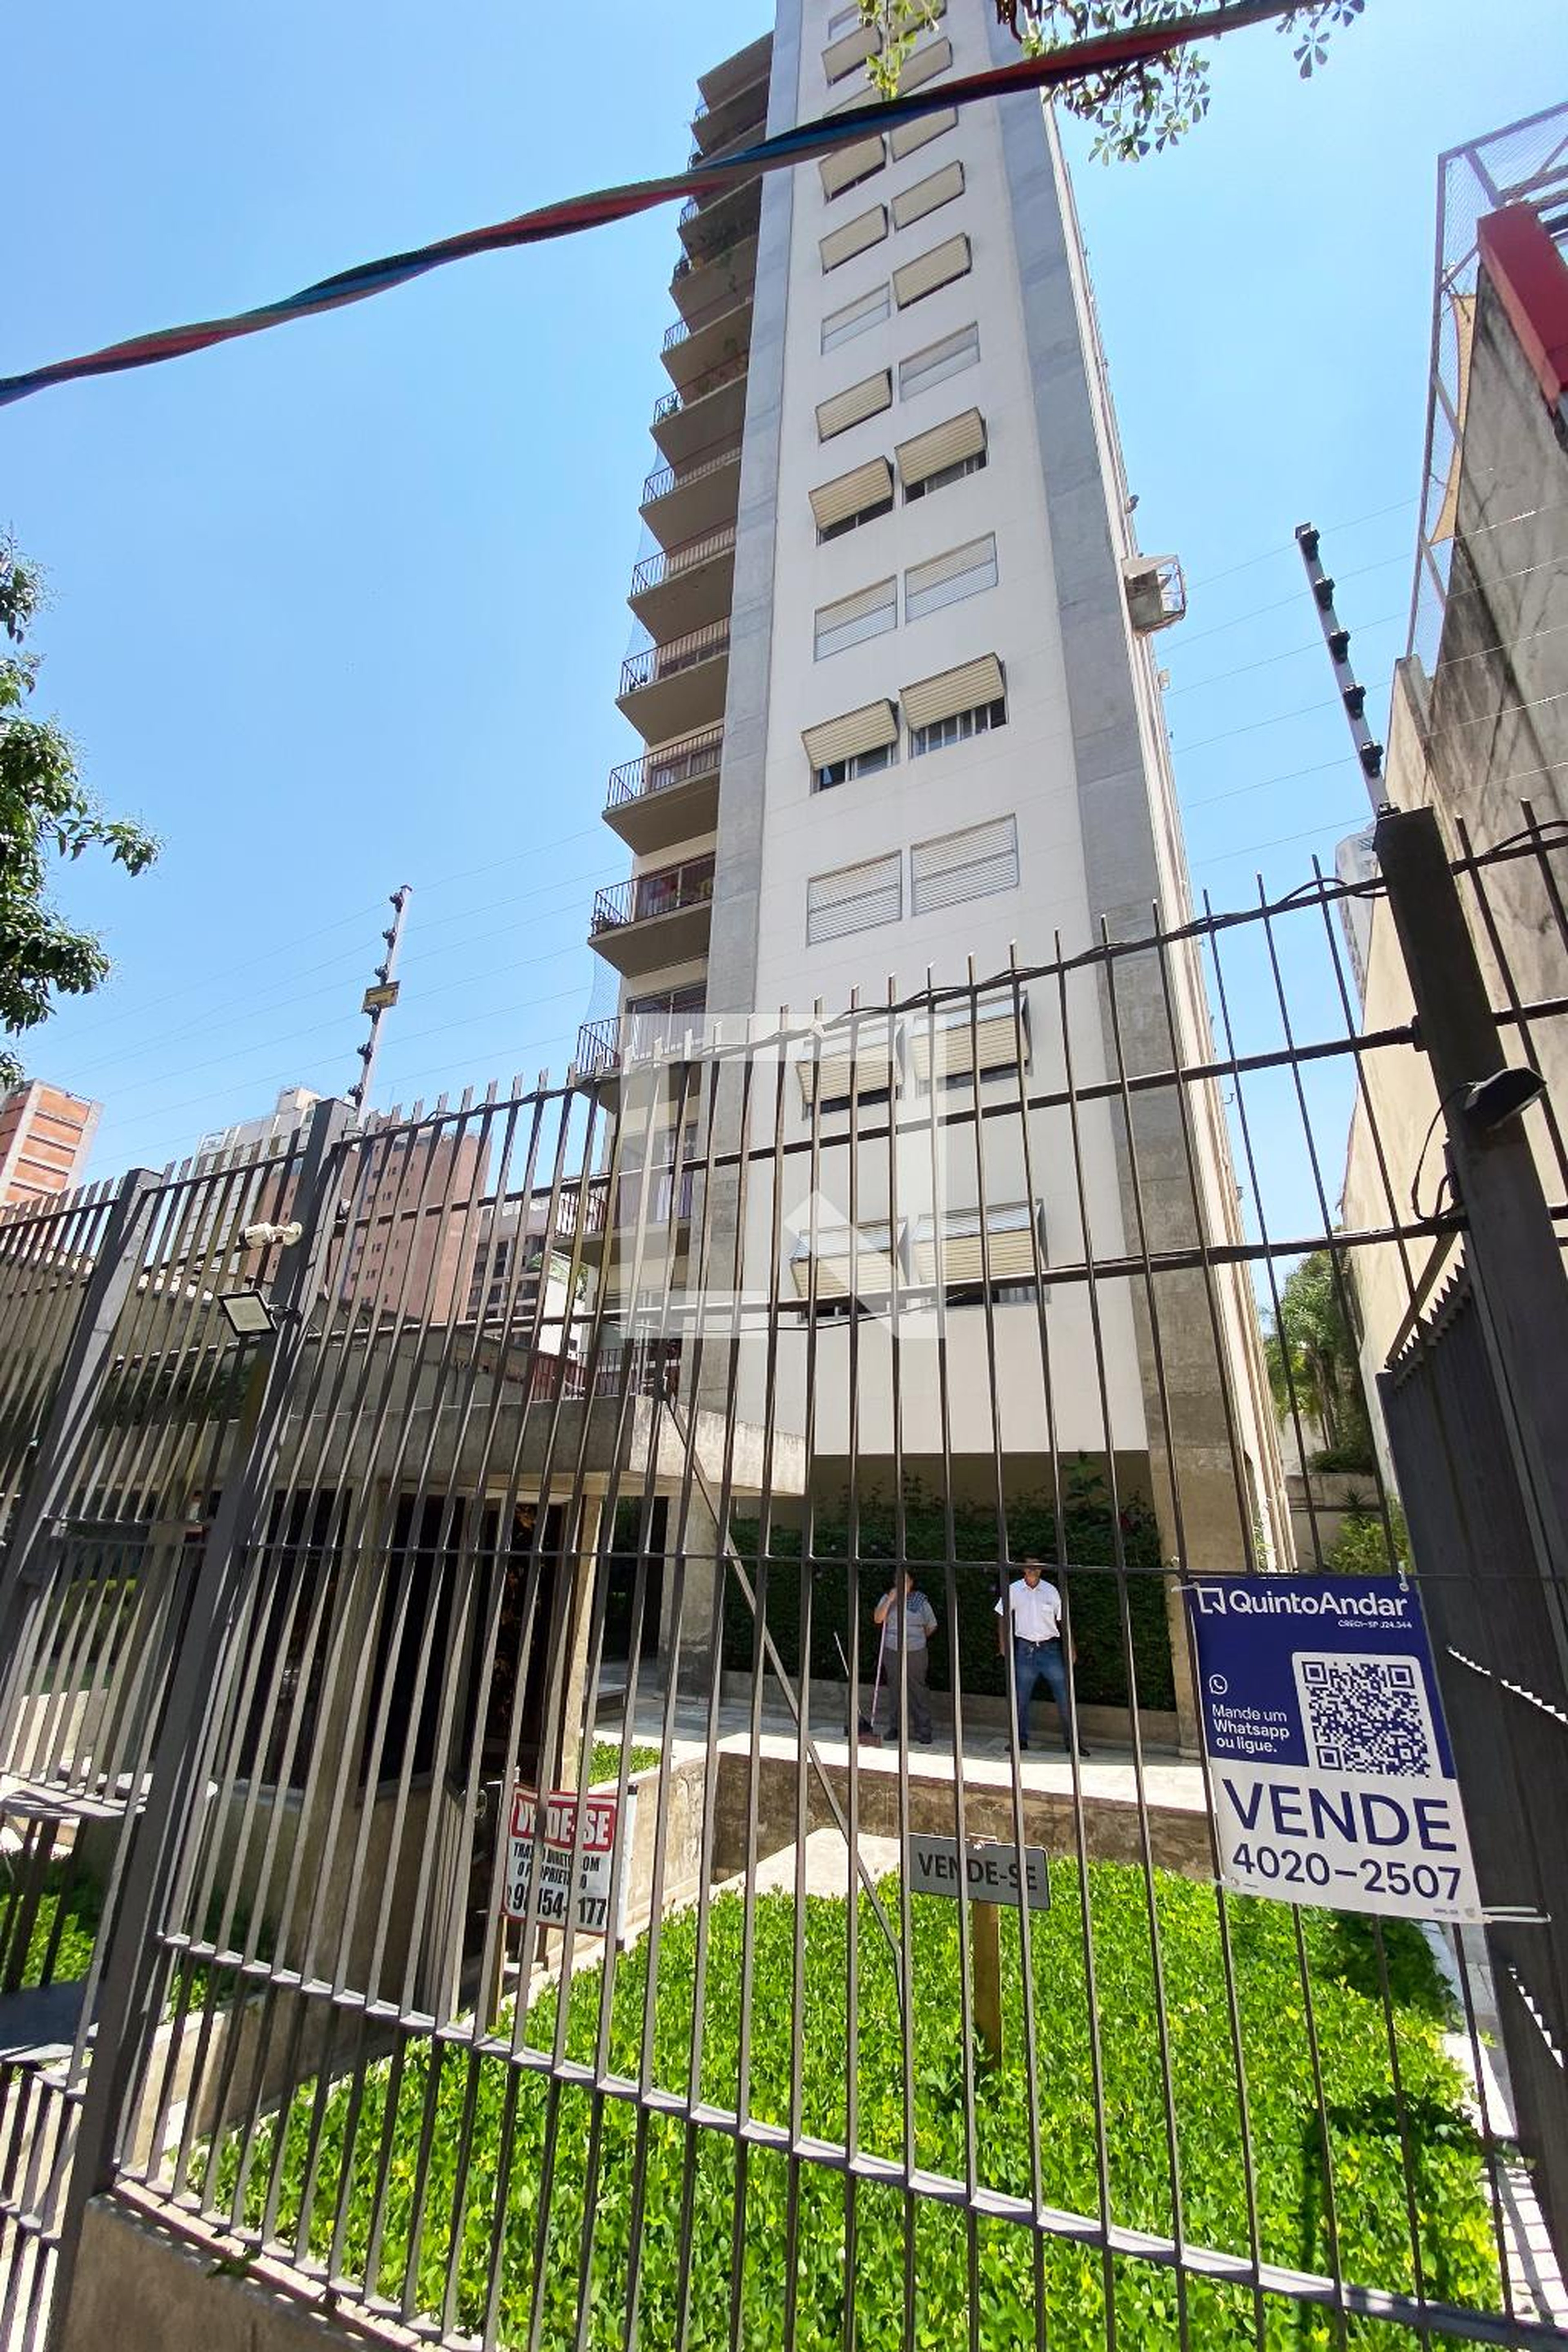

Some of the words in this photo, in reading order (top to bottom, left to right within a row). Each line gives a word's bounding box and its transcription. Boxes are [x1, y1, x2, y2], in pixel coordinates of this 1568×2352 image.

[1229, 1590, 1407, 1616] QuintoAndar
[1212, 1704, 1261, 1720] Mande
[1263, 1711, 1287, 1722] um
[1213, 1718, 1290, 1741] Whatsapp
[1216, 1737, 1234, 1748] ou
[1236, 1736, 1277, 1754] ligue.
[1222, 1779, 1457, 1852] VENDE
[580, 1855, 601, 1871] OM
[1232, 1843, 1461, 1900] 4020-2507
